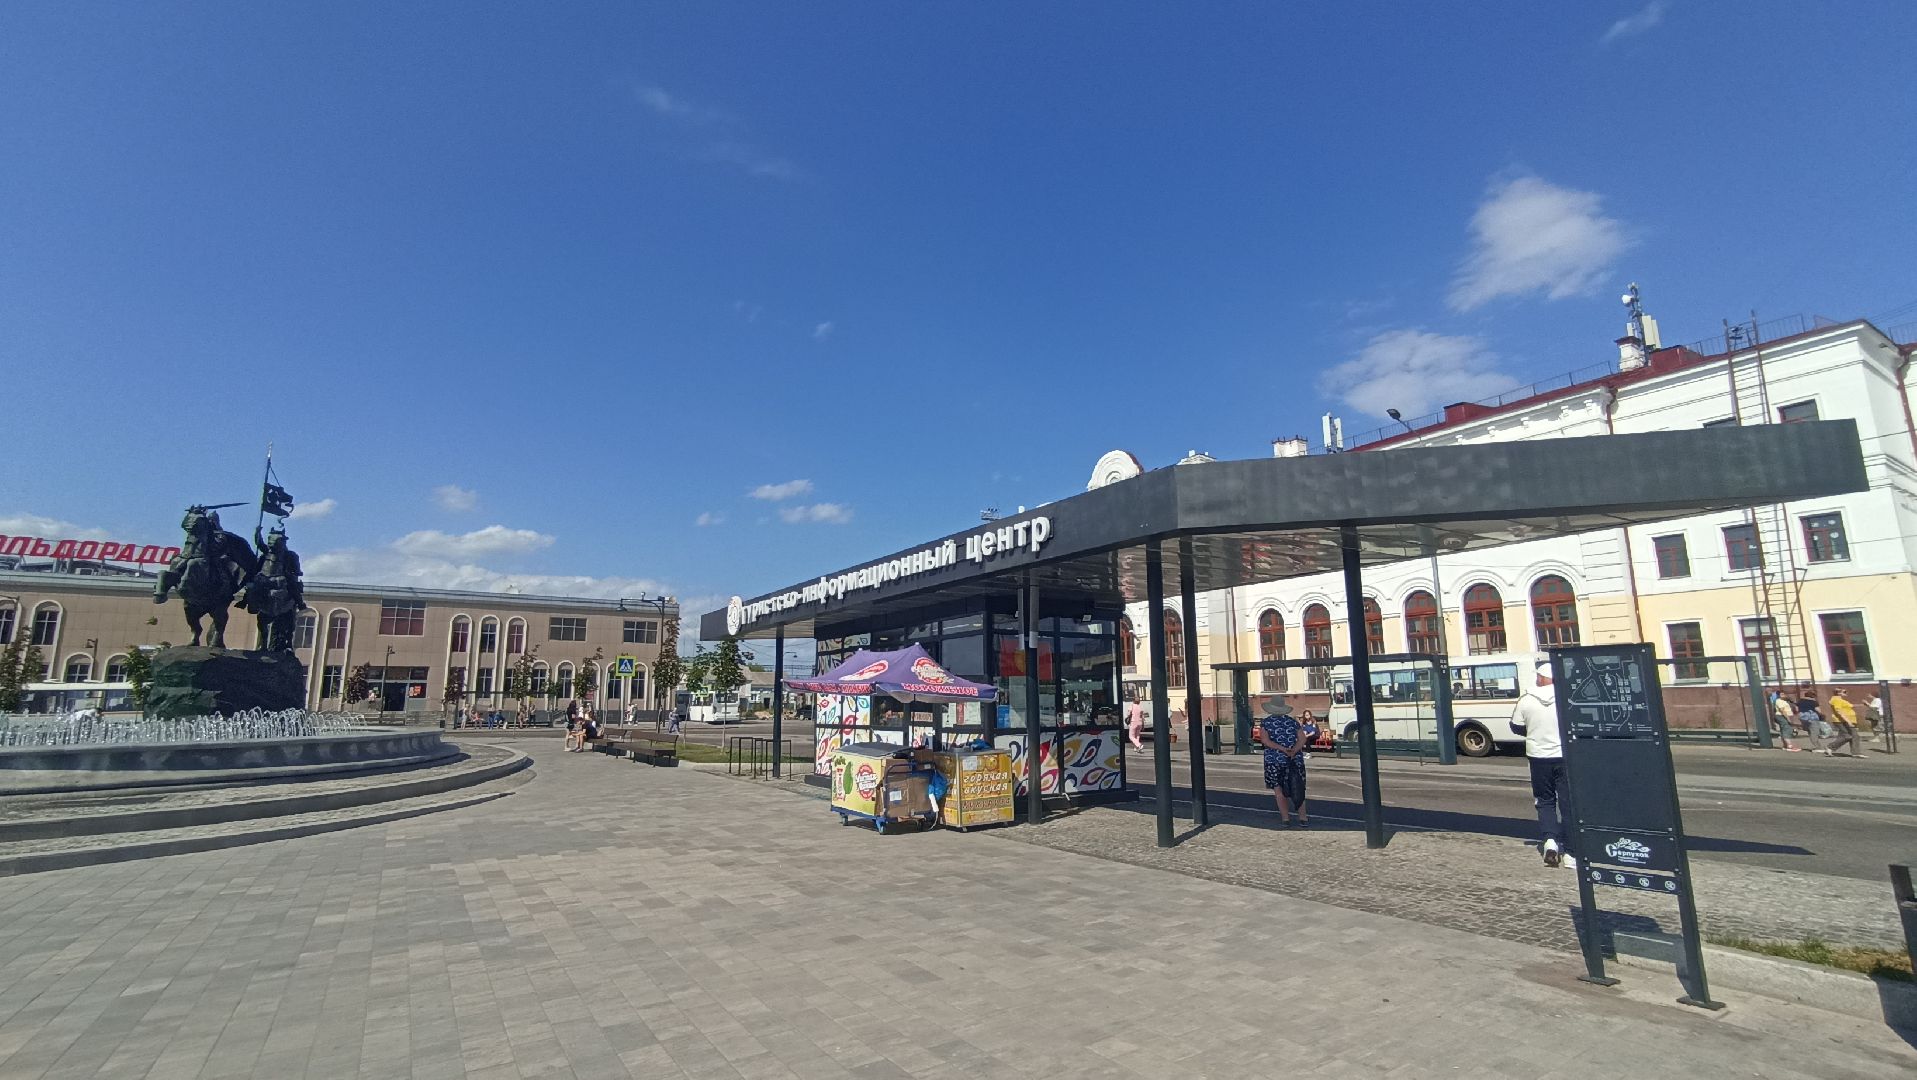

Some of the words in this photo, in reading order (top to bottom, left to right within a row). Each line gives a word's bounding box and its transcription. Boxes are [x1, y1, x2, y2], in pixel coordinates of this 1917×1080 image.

[741, 539, 957, 625] туристско-информационный
[965, 515, 1051, 563] центр
[963, 771, 1008, 785] горячая
[963, 782, 1008, 797] вкусная
